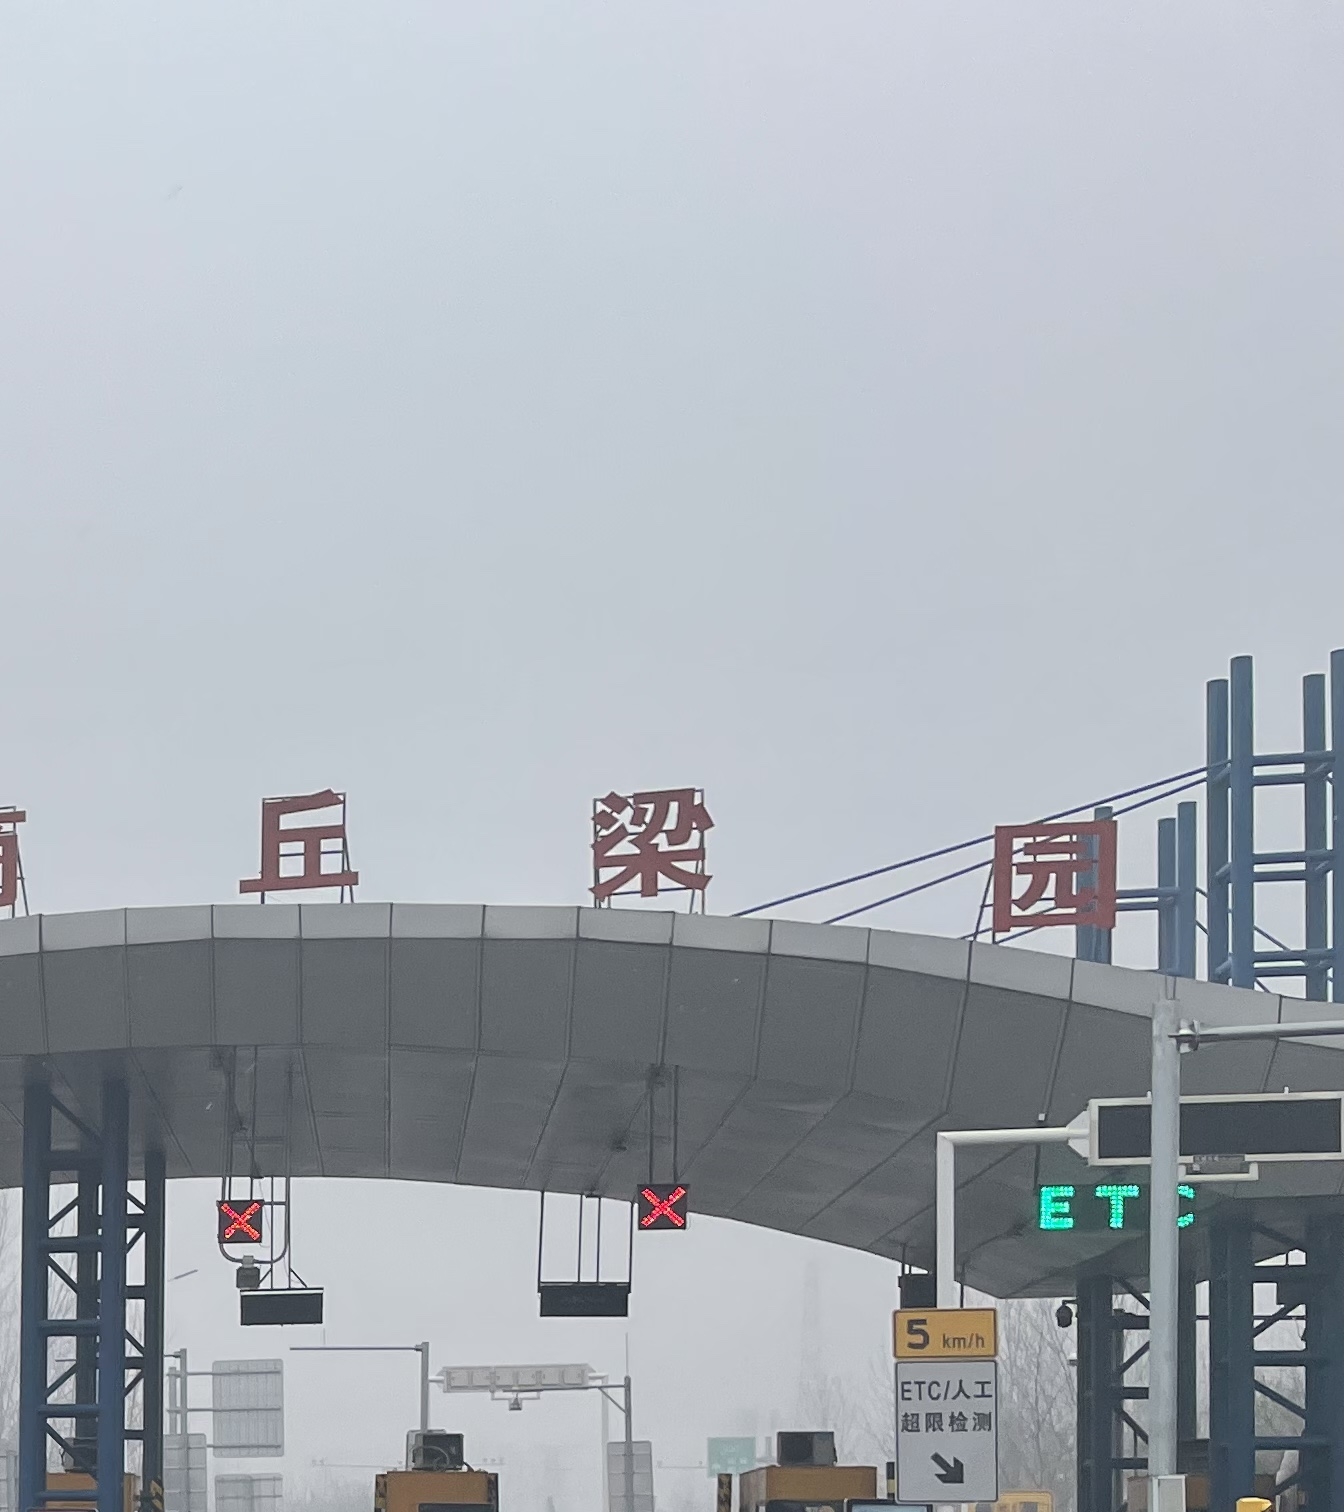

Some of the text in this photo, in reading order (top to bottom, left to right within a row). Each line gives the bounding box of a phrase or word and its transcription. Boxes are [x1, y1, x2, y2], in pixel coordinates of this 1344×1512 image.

[907, 1318, 986, 1350] 5 km/h
[900, 1379, 993, 1401] ETC/人工
[900, 1411, 992, 1433] 超限检测
